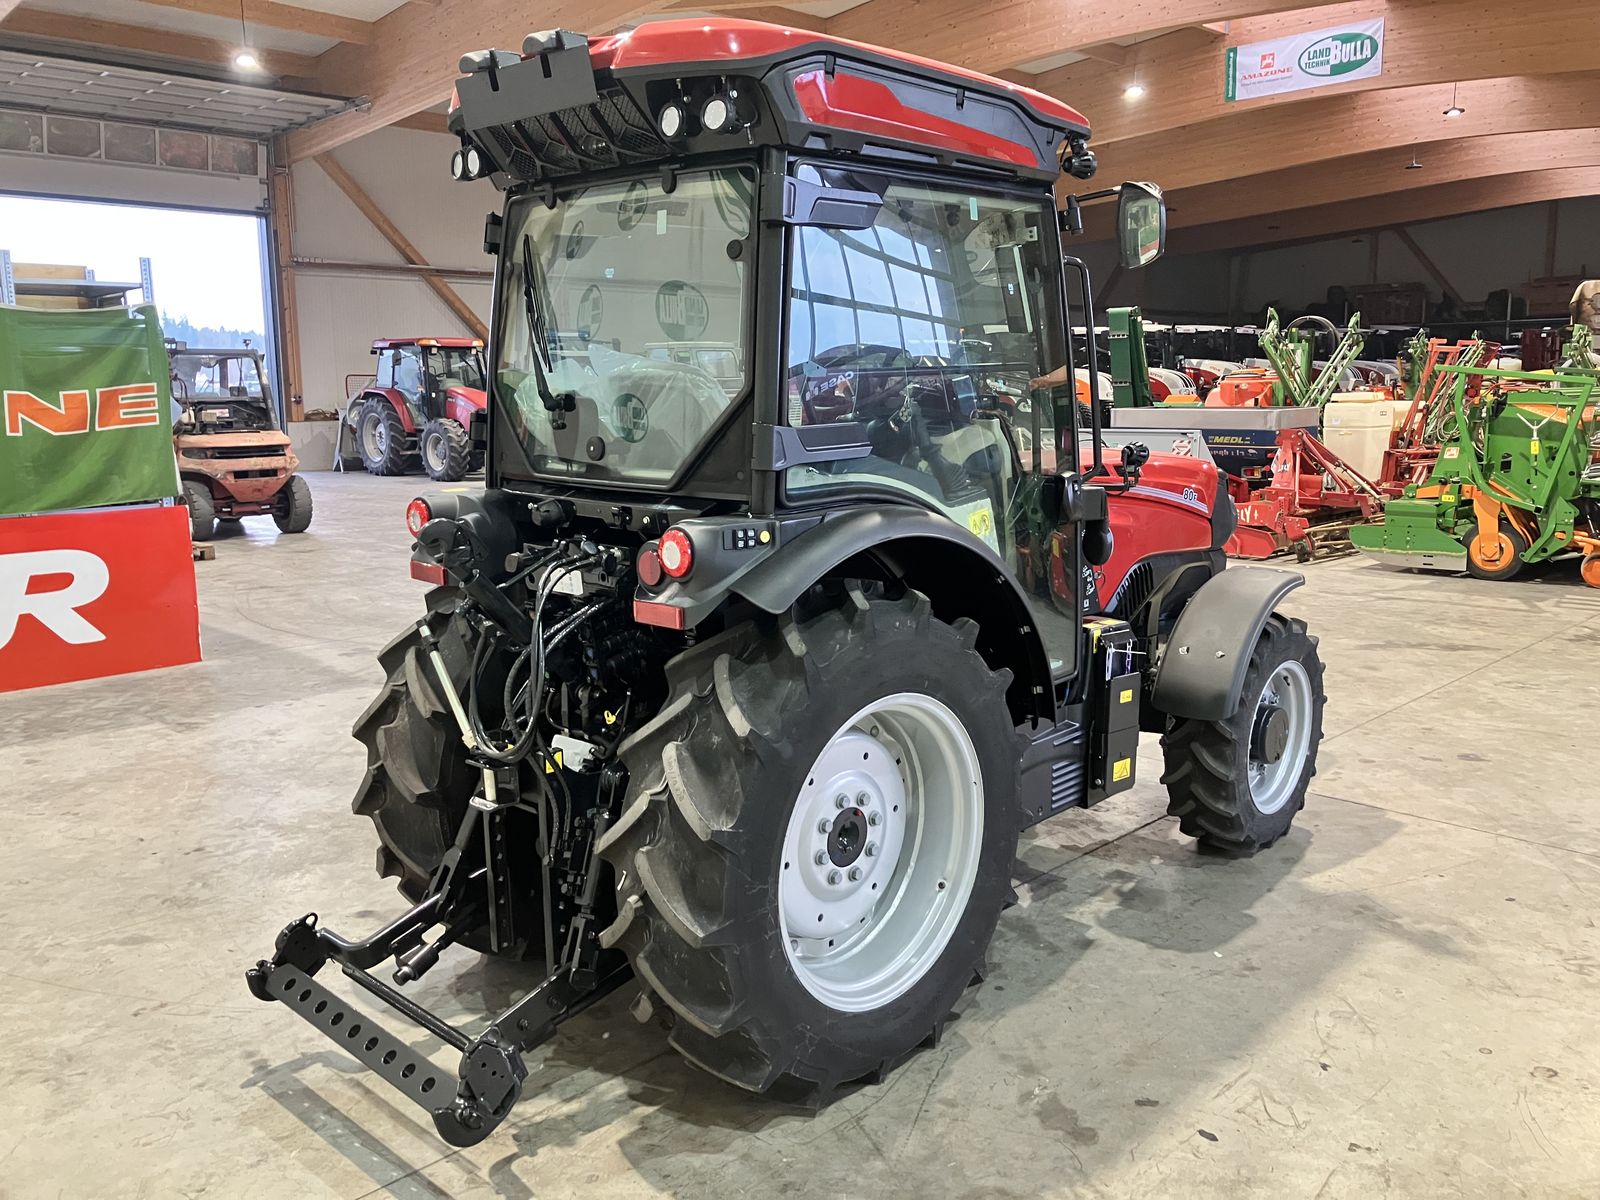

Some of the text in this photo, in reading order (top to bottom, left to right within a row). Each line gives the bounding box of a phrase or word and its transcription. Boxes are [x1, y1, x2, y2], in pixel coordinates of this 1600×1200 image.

[1307, 47, 1331, 61] LAND
[1331, 39, 1372, 65] BULLA
[1304, 58, 1331, 70] TECHNIK
[1241, 67, 1293, 80] AMAZONE
